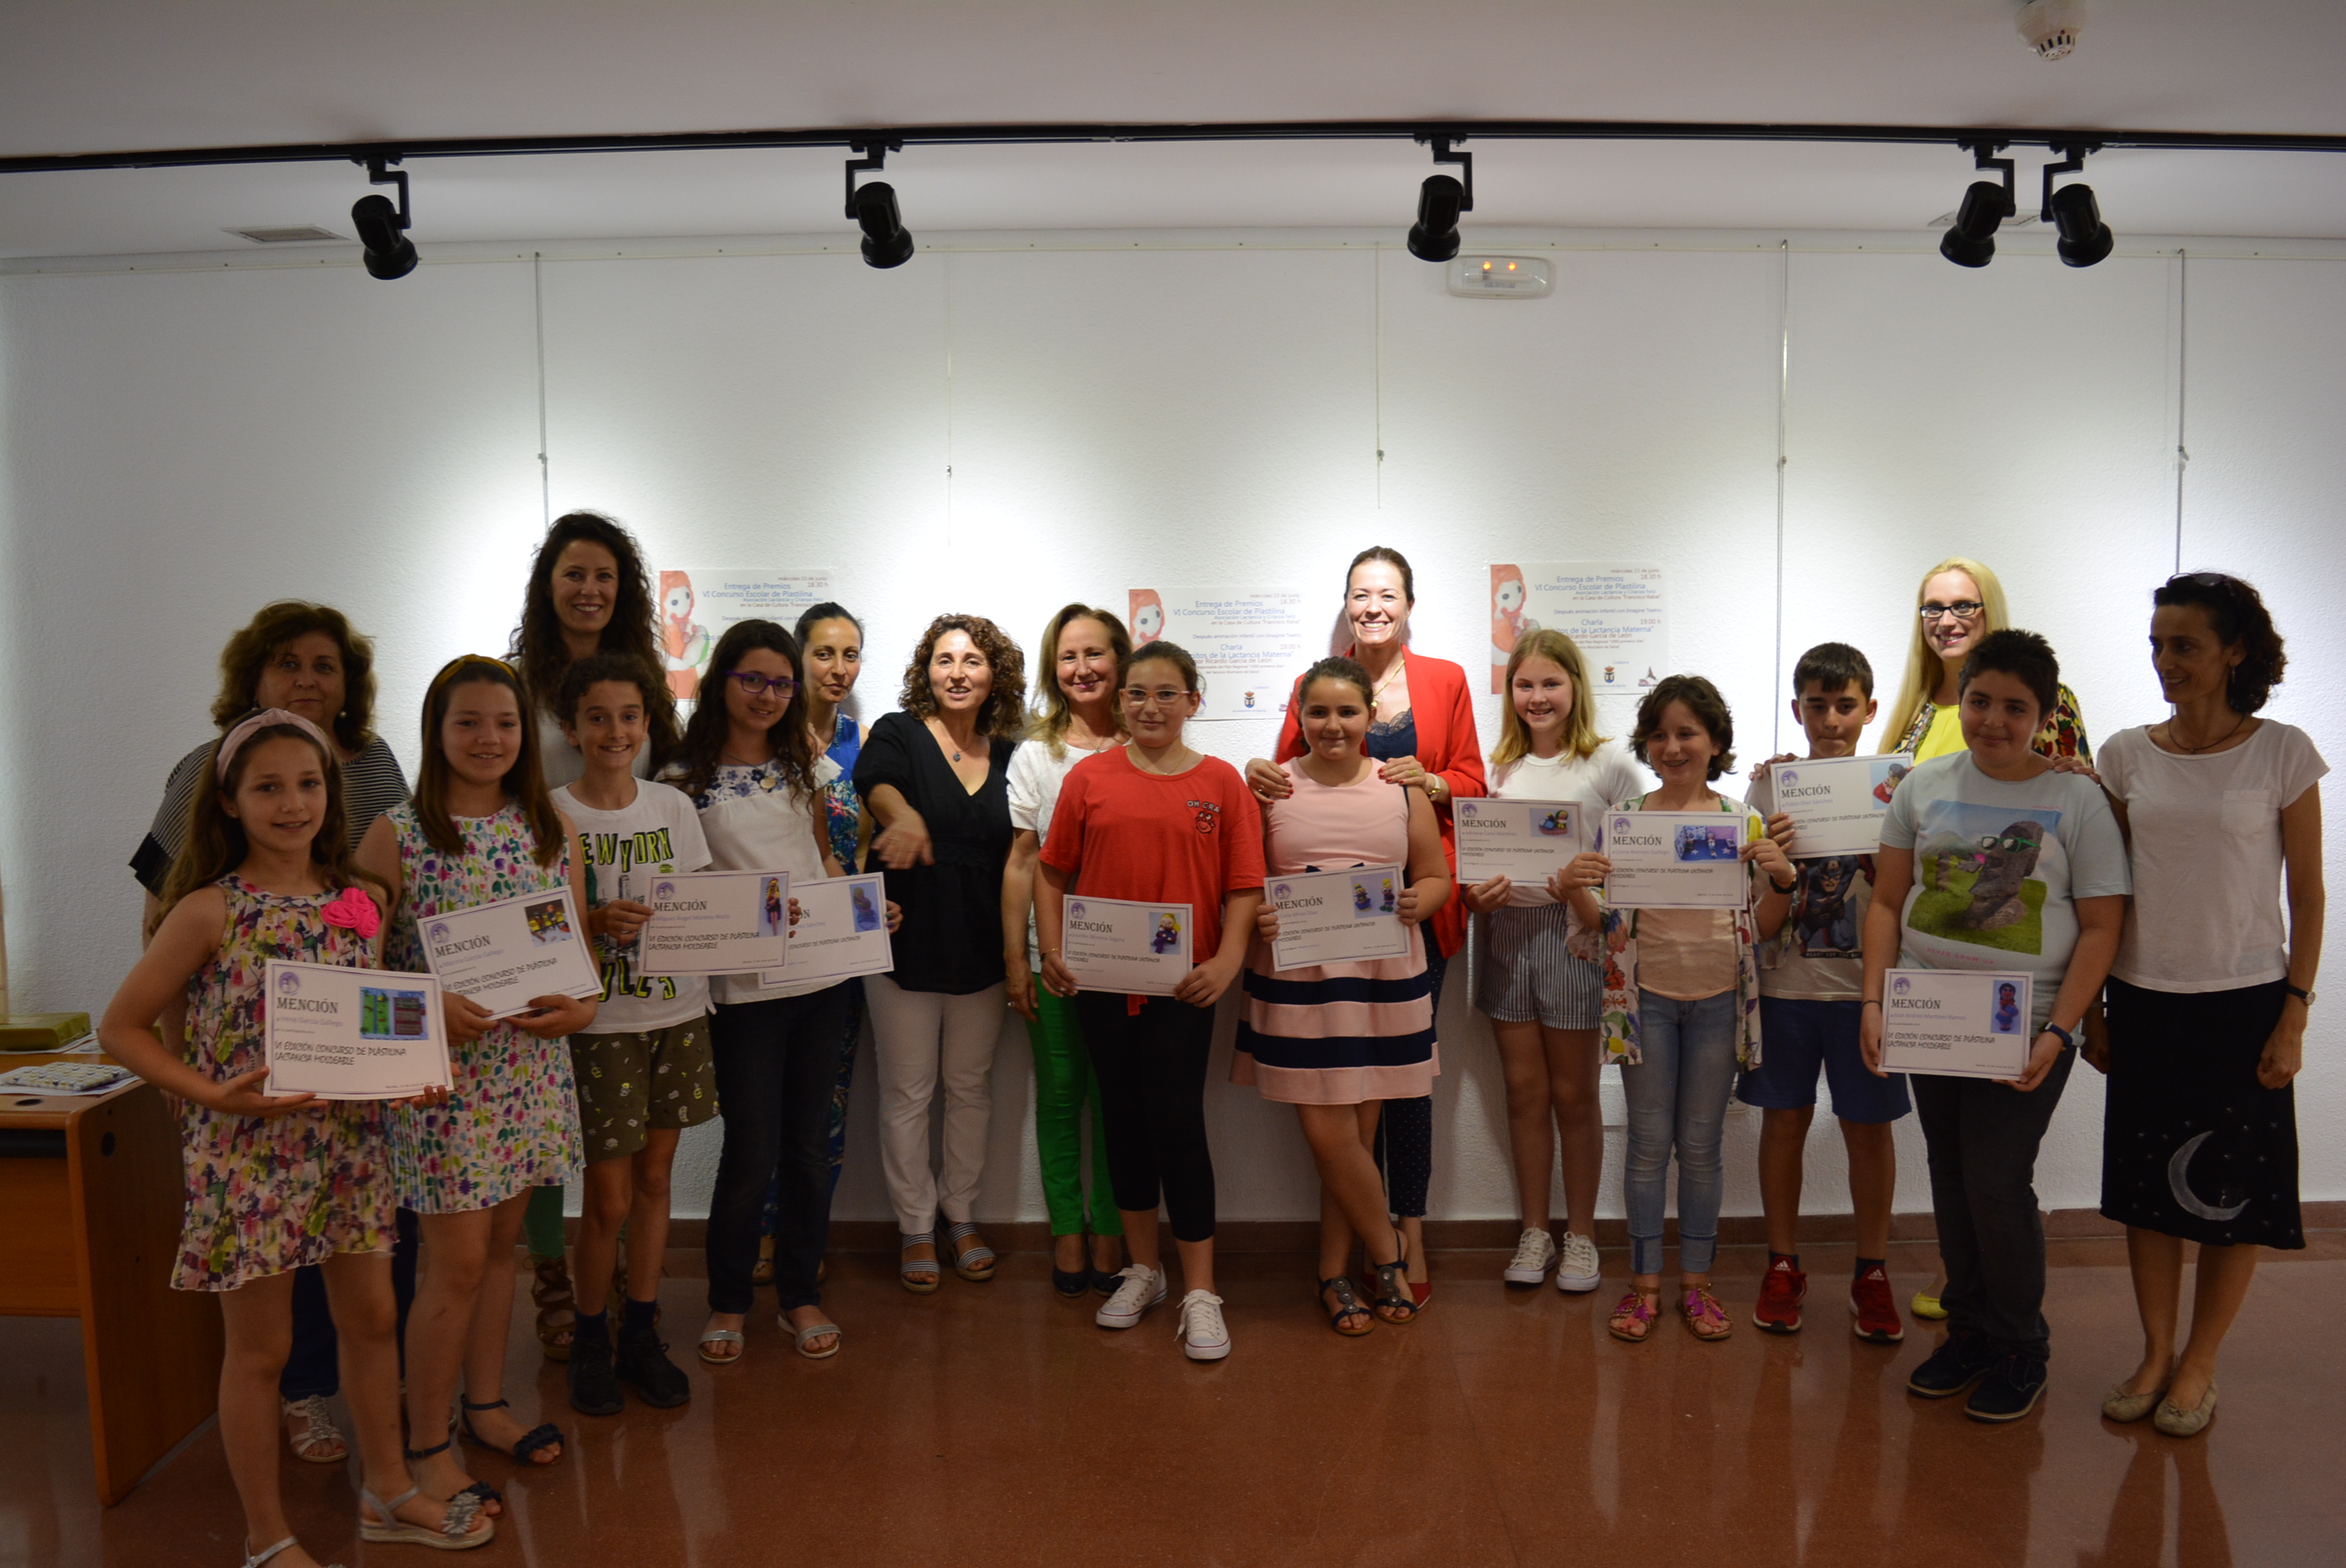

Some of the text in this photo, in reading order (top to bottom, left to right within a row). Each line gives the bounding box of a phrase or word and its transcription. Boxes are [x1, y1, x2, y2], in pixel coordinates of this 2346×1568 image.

[1781, 784, 1831, 798] MENCIÓN
[1202, 801, 1220, 813] CRA
[1462, 818, 1506, 828] MENCIÓN
[1613, 834, 1662, 845] MENCIÓN
[579, 833, 619, 866] EW
[652, 899, 707, 911] MENCIÓN
[1276, 895, 1323, 909] MENCIÓN
[1070, 920, 1113, 933] MENCIÓN
[435, 935, 491, 957] MENCIÓN
[457, 986, 481, 996] TANCIA
[277, 997, 339, 1013] MENCIÓN
[1891, 997, 1941, 1009] MENCIÓN
